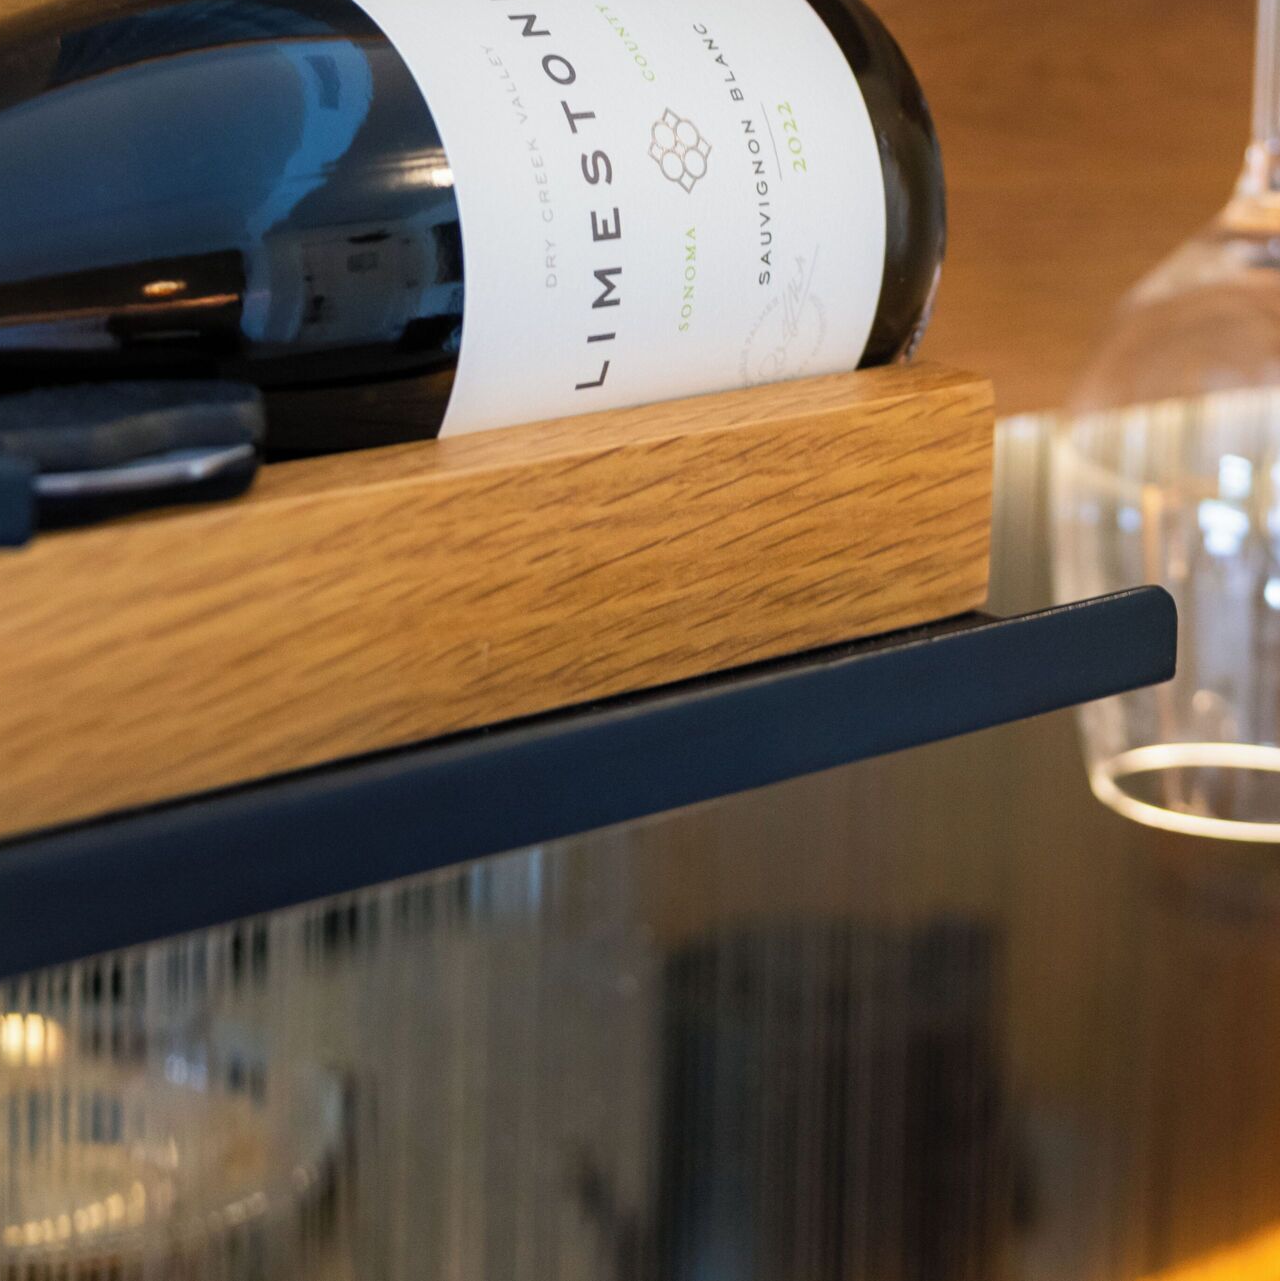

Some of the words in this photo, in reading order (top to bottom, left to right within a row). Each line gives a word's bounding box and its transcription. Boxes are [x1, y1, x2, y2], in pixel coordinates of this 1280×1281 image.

[596, 4, 656, 83] COUNTY
[693, 23, 744, 102] BLANC
[481, 45, 528, 124] VALLEY
[777, 102, 807, 172] 2022
[526, 138, 554, 223] CREEK
[741, 120, 772, 285] SAUVIGNON
[544, 239, 558, 288] DRY
[678, 227, 696, 331] SONOMA
